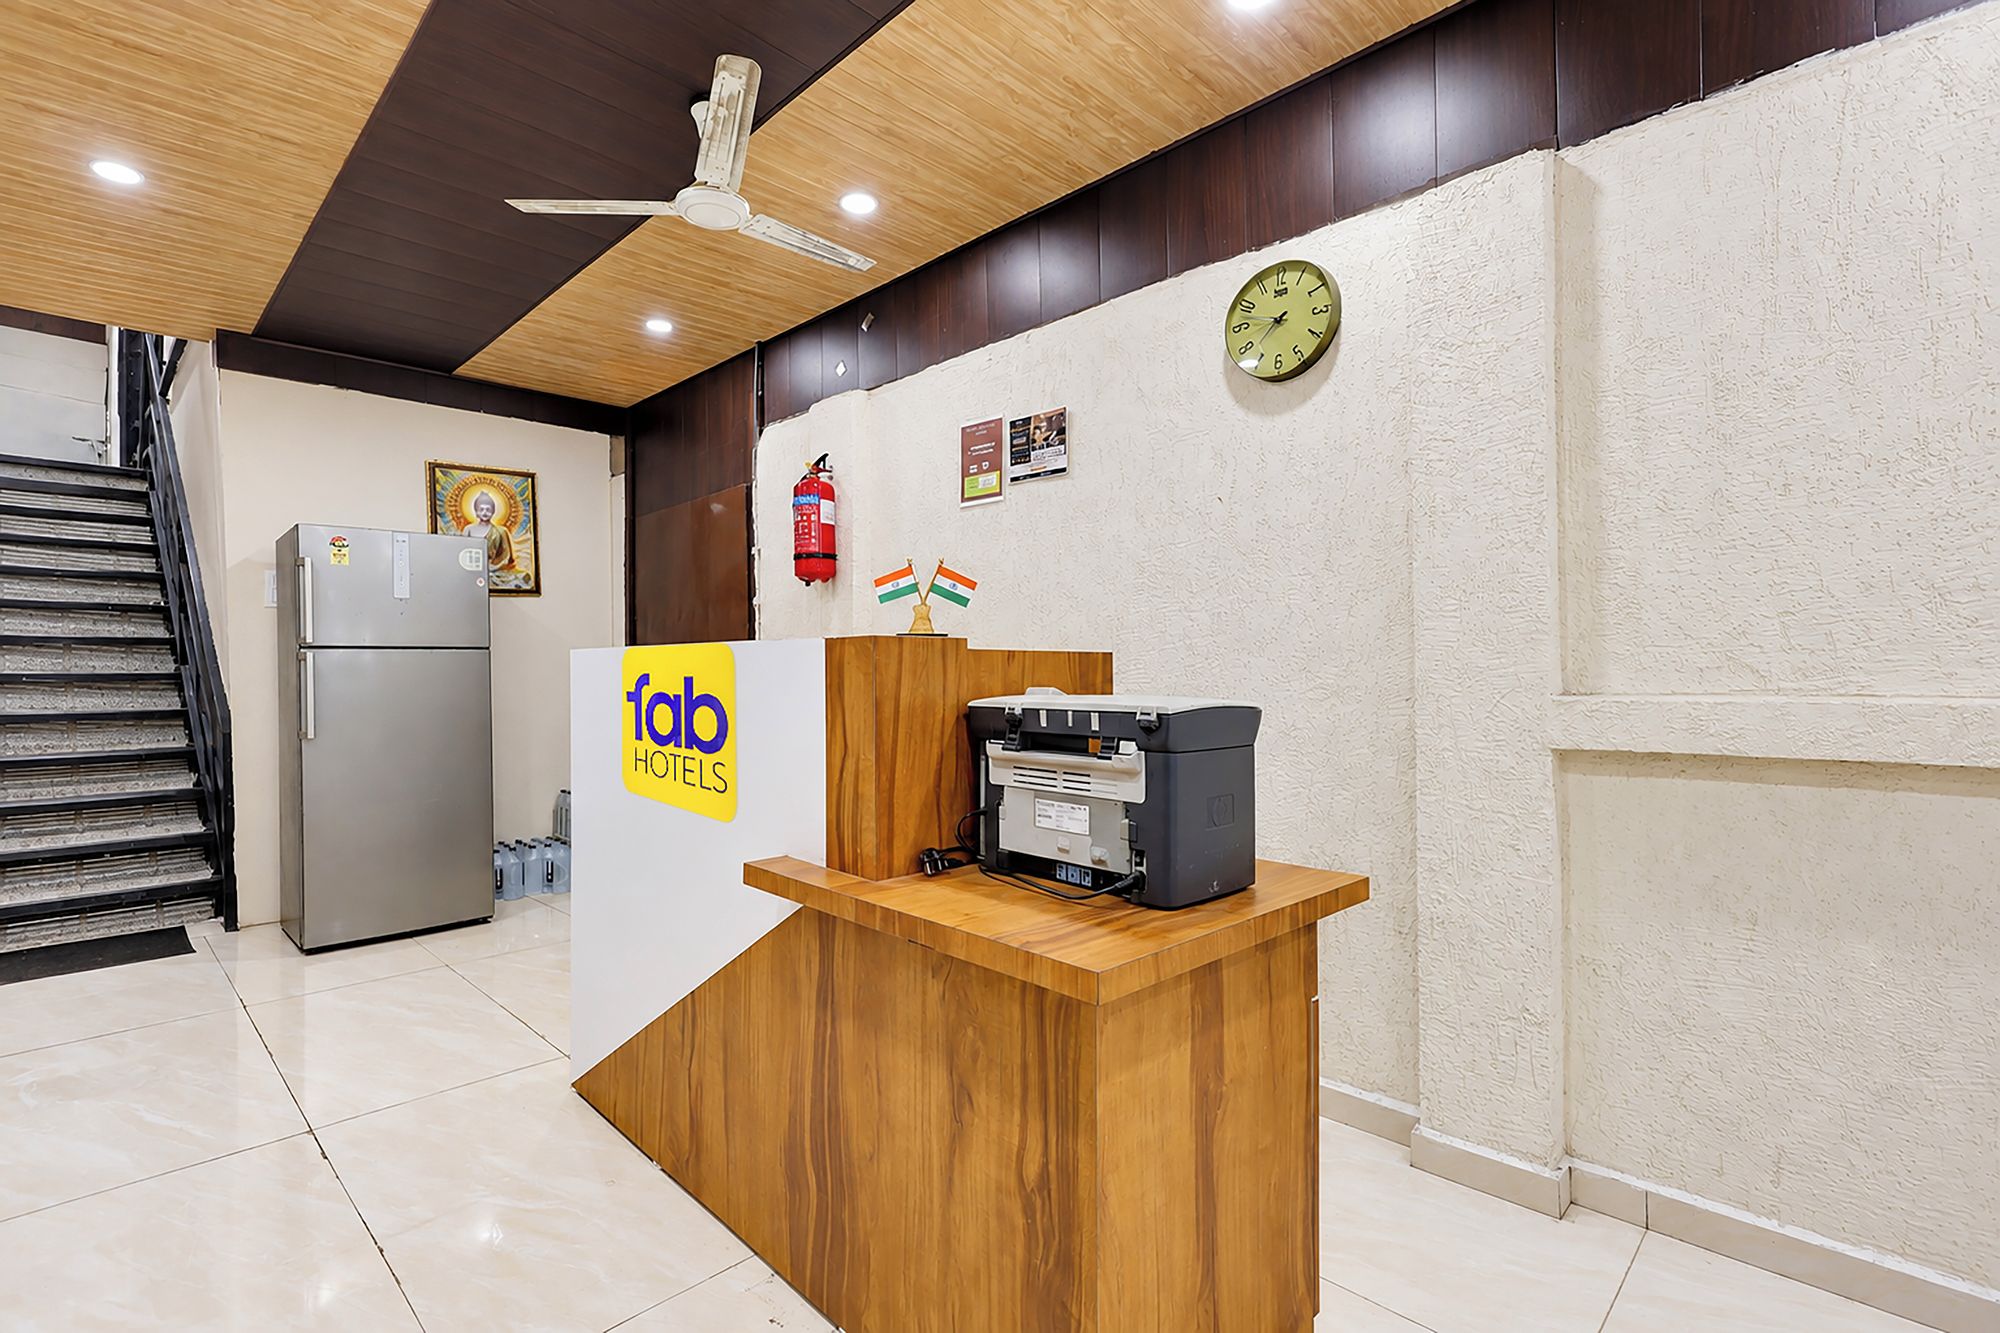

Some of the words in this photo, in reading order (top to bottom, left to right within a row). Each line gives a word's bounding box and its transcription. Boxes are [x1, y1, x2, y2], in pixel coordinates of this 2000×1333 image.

[1277, 266, 1287, 287] 12
[1296, 266, 1308, 286] 1
[1255, 280, 1268, 295] 11
[1239, 299, 1256, 314] 10
[1312, 303, 1332, 315] 3
[1232, 322, 1250, 334] 9
[1239, 341, 1254, 355] 8
[1292, 344, 1304, 361] 5
[1274, 354, 1283, 370] 6
[626, 673, 728, 755] fab
[635, 747, 728, 794] HOTELS
